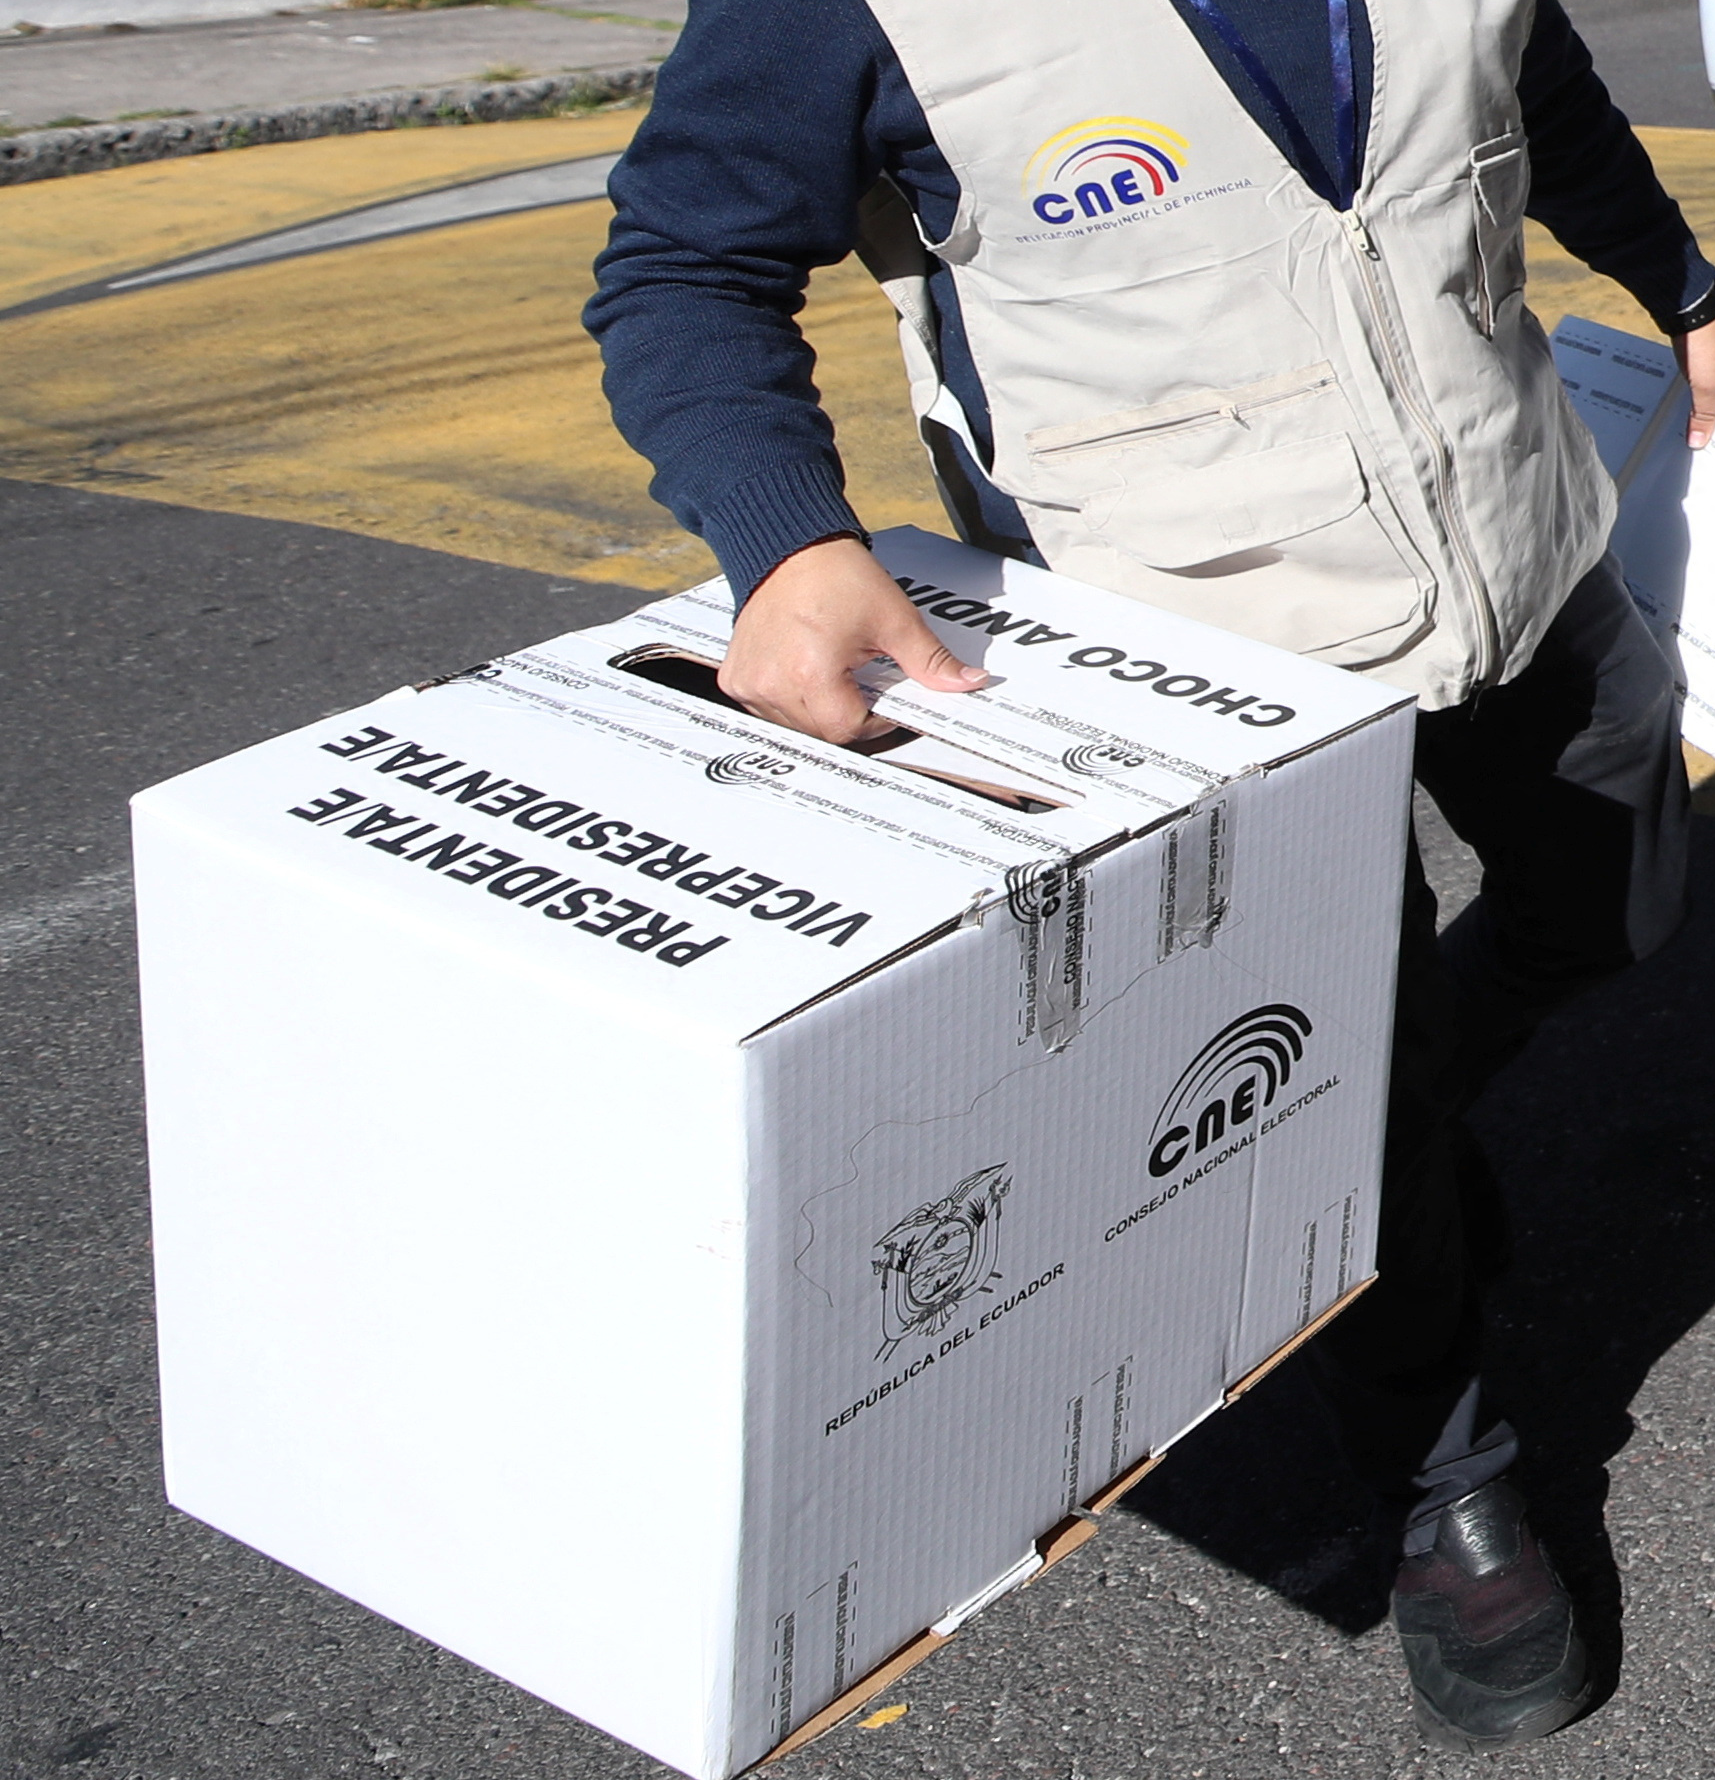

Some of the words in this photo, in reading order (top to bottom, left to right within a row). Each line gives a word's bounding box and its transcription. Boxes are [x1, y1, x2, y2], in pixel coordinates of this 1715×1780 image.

[1164, 199, 1182, 212] DE
[1184, 177, 1254, 206] PICHINCHA
[895, 576, 1079, 648] ANDIN
[1027, 706, 1109, 737] ELECTORAL
[1060, 645, 1297, 728] CHOCÓ
[1099, 733, 1172, 761] NACIONAL
[285, 786, 732, 969] PRESIDENTA/E
[318, 725, 873, 949] VICEPRESIDENTA/E
[1062, 911, 1079, 987] CONSEJO
[1103, 1182, 1179, 1244] CONSEJO
[1182, 1131, 1257, 1191] NACIONAL
[1260, 1074, 1341, 1137] ELECTORAL
[1148, 1074, 1257, 1178] CNE
[824, 1354, 935, 1437] REPÚBLICA
[939, 1327, 975, 1358] DEL
[979, 1261, 1067, 1329] ECUADOR
